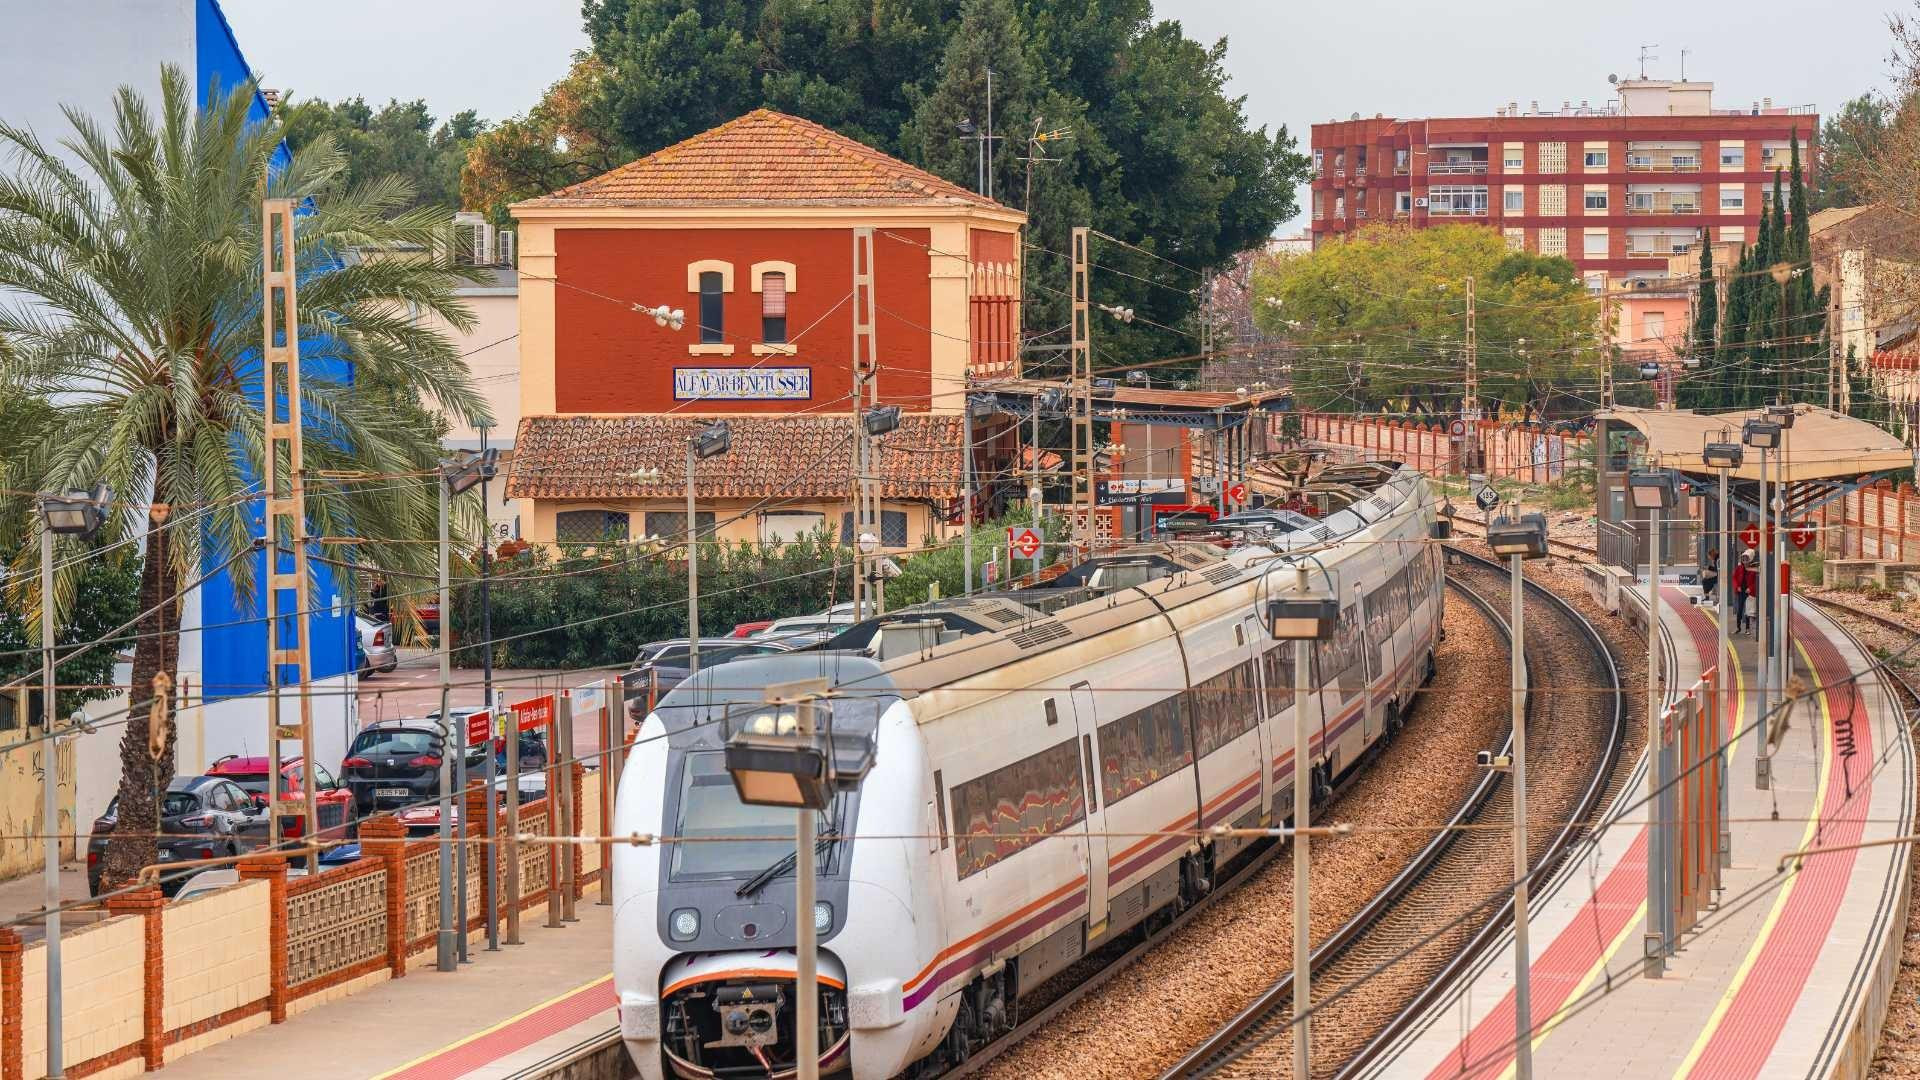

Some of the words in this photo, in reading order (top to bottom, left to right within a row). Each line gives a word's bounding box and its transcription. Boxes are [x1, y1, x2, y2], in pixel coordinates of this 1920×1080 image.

[1236, 486, 1245, 499] 2
[1023, 535, 1034, 552] 2
[1747, 529, 1757, 544] 1
[1796, 528, 1806, 545] 3
